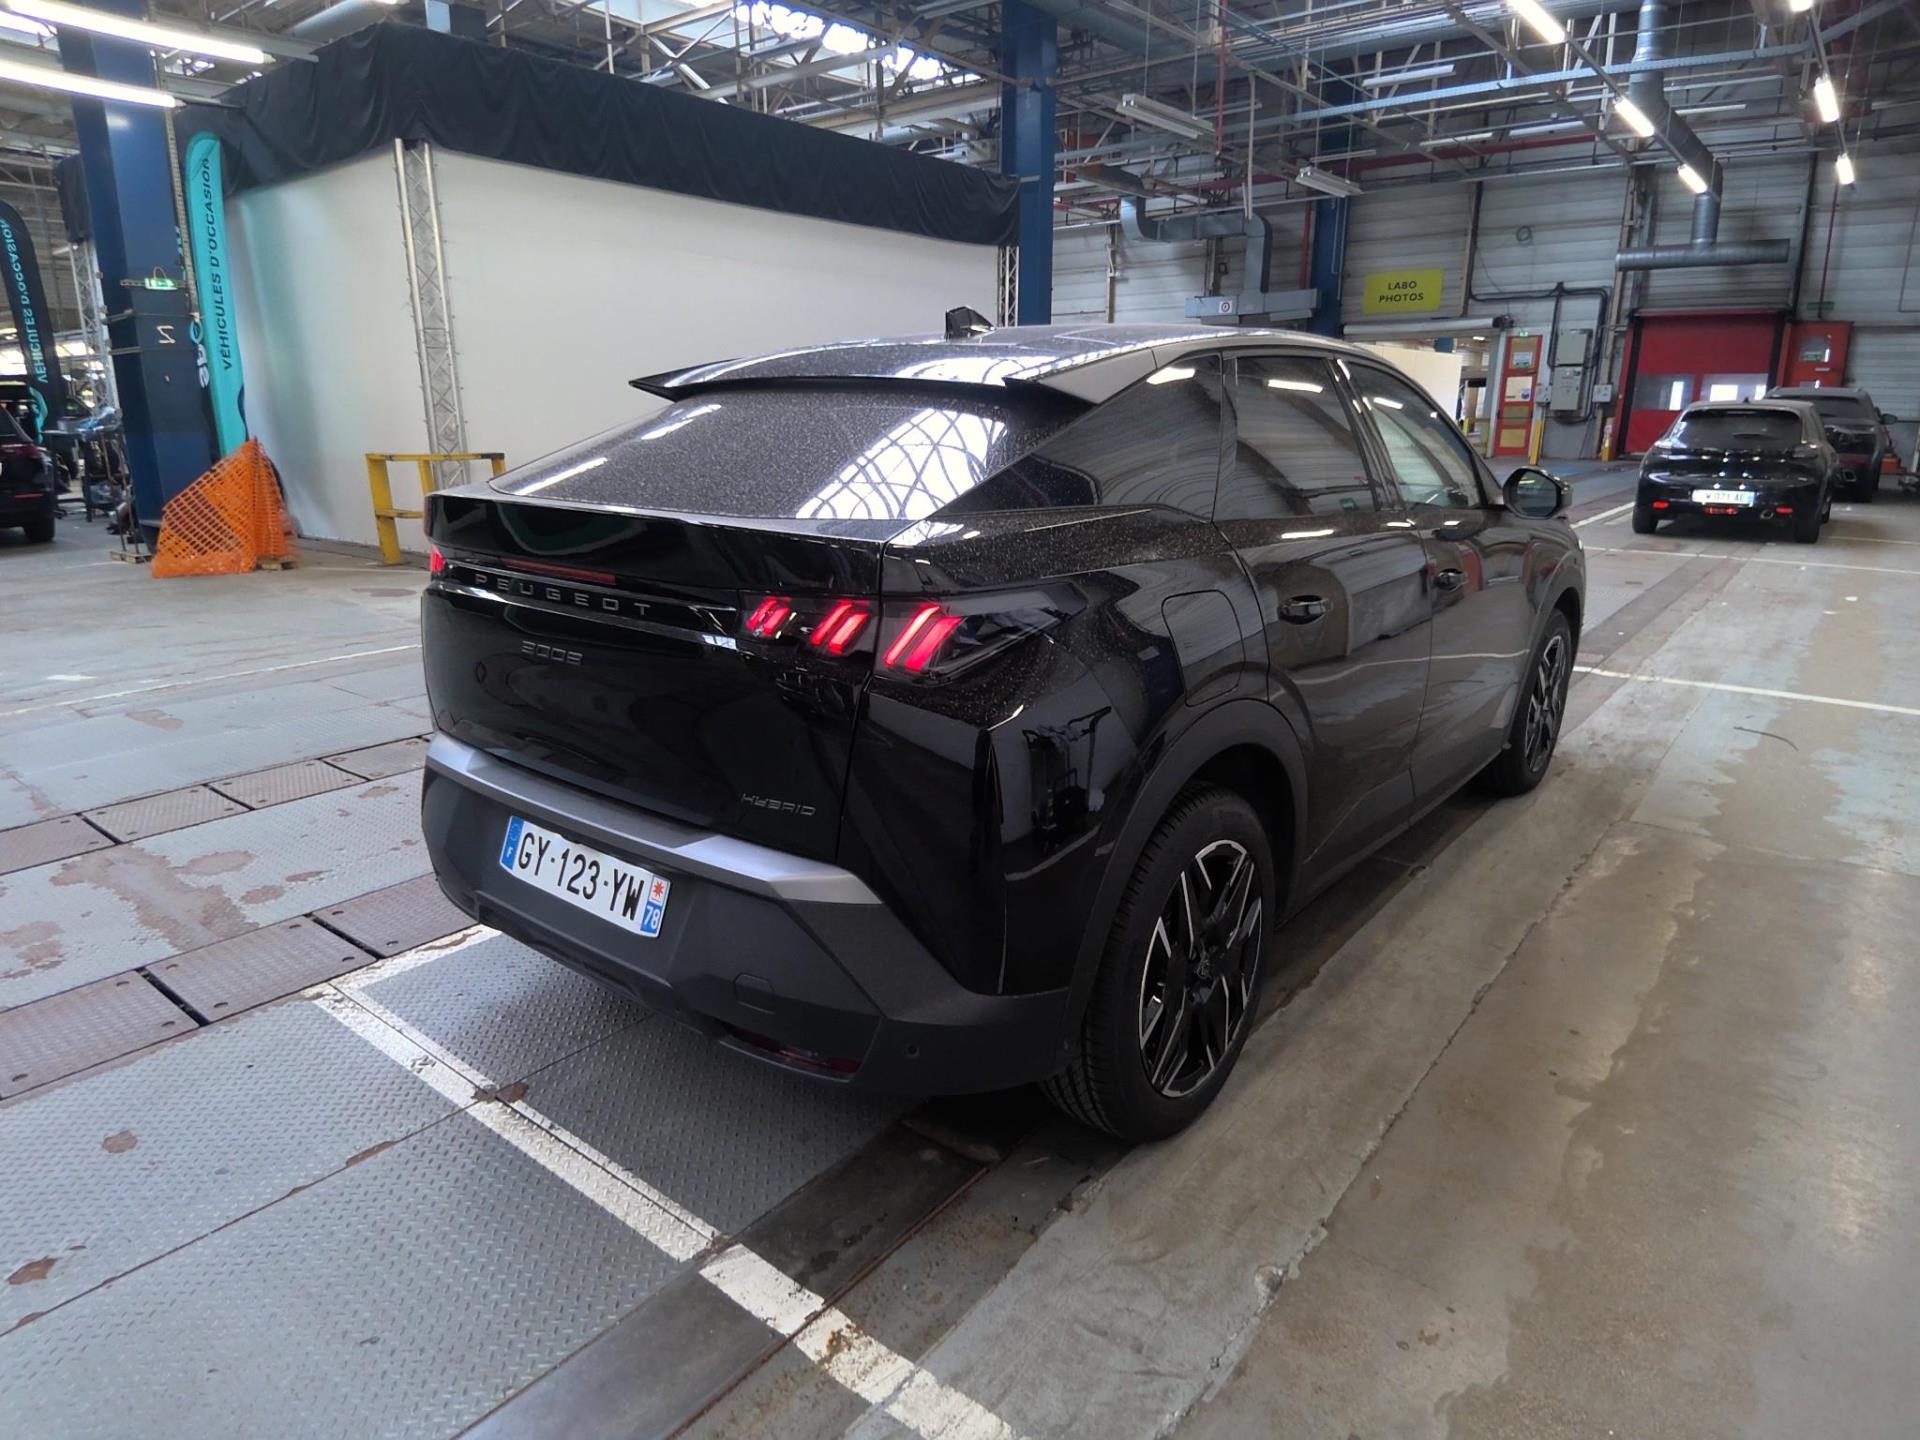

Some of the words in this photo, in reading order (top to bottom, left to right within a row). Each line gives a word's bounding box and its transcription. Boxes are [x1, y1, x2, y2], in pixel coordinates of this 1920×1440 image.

[202, 158, 220, 268] D'OCCASION
[1379, 293, 1424, 303] PHOTOS
[1388, 281, 1417, 291] LABO
[211, 272, 232, 371] VÉHICULES
[475, 573, 651, 616] PEUGEOT
[742, 793, 815, 816] HYBRID
[643, 905, 661, 930] 78
